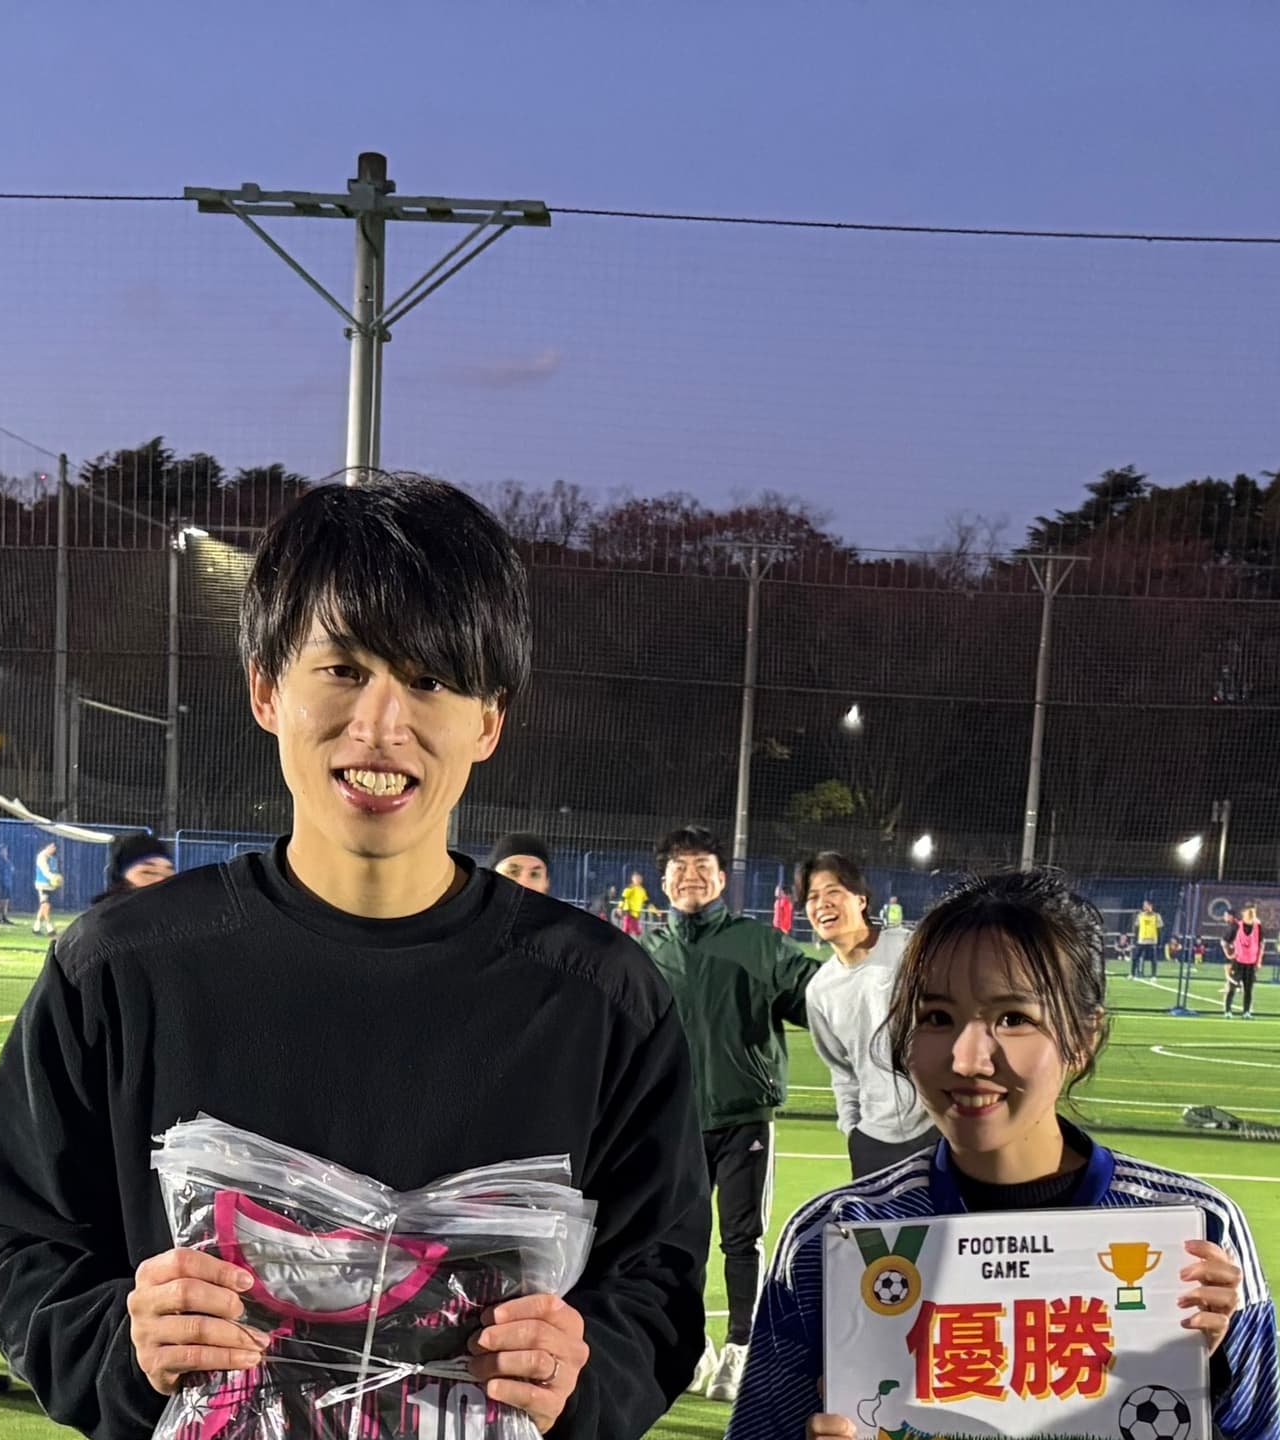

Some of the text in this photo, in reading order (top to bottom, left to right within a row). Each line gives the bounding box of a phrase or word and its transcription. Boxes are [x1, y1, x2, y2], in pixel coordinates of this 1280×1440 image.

[958, 1235, 1054, 1255] FOOTBALL
[982, 1261, 1030, 1279] GAME
[906, 1295, 1117, 1402] 優勝
